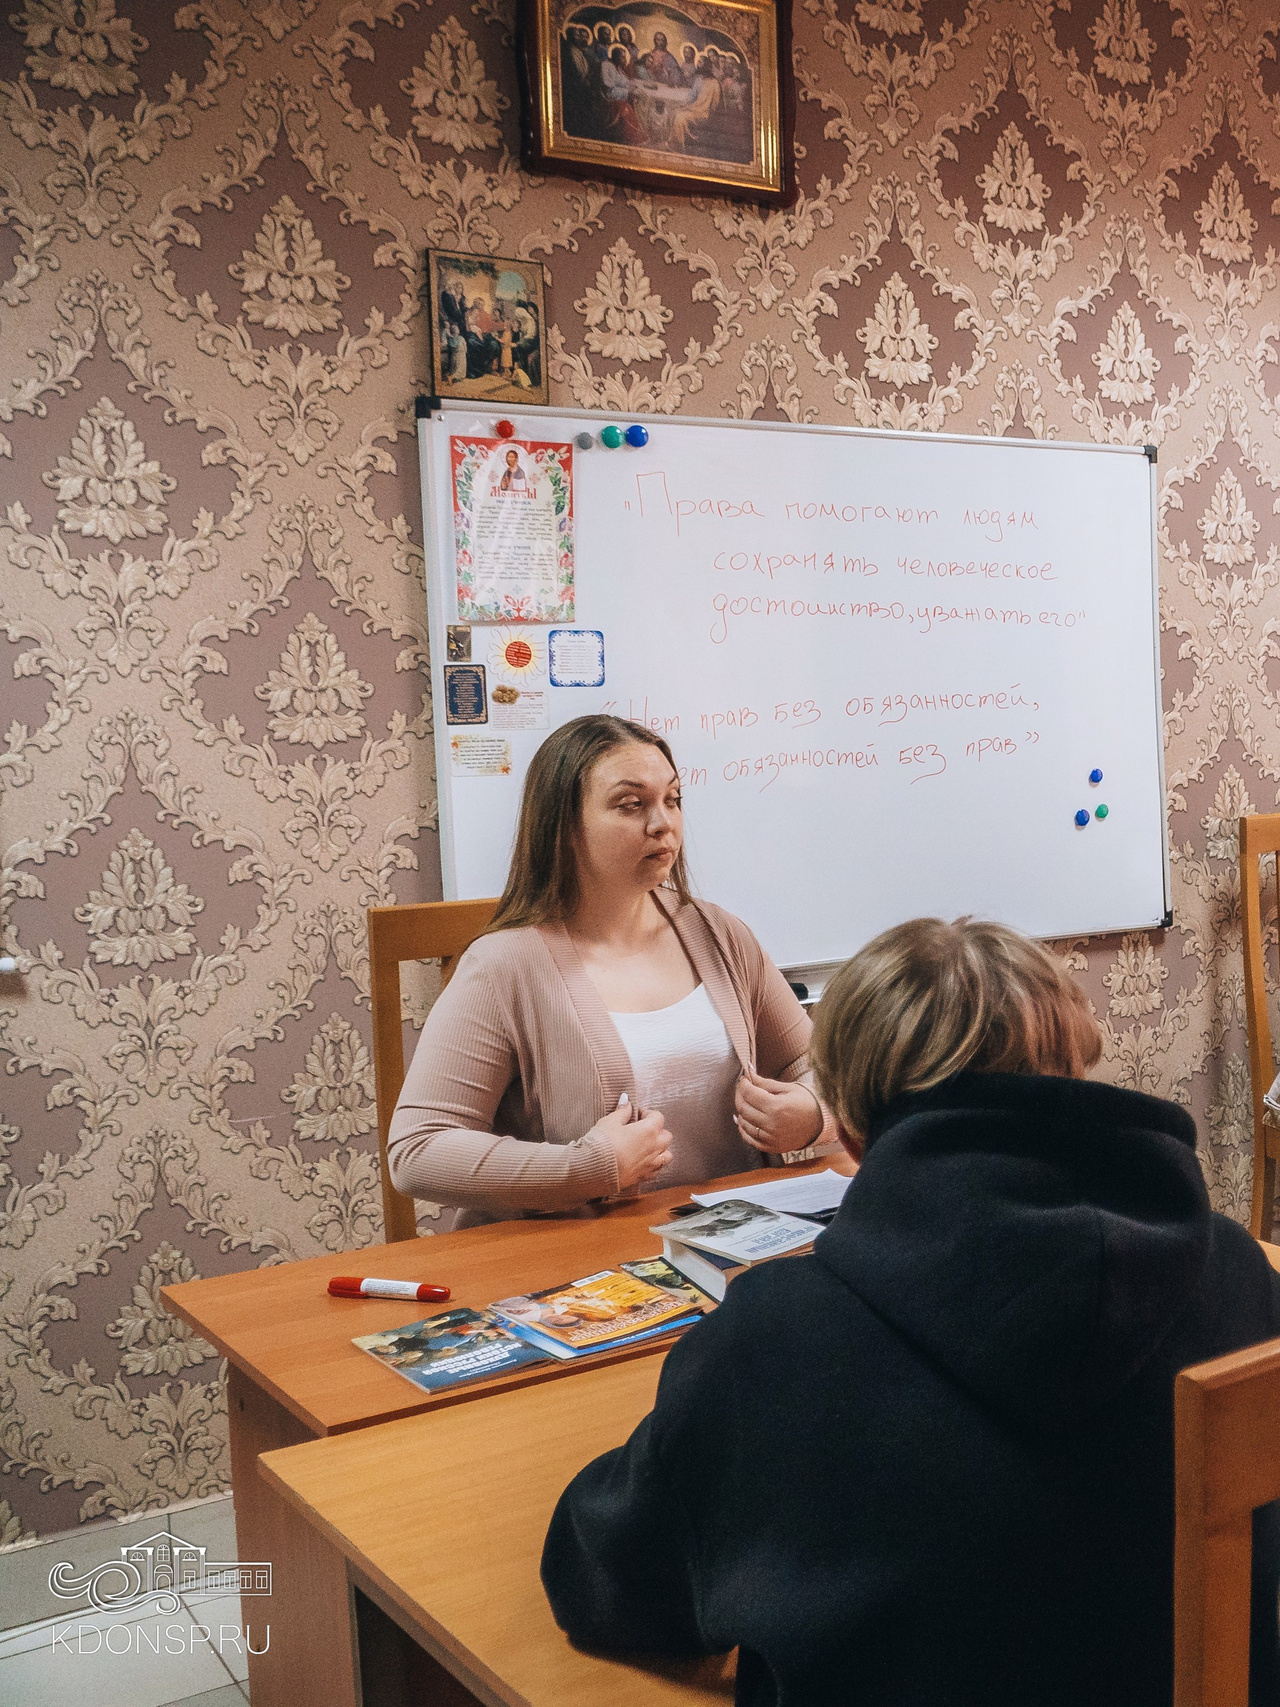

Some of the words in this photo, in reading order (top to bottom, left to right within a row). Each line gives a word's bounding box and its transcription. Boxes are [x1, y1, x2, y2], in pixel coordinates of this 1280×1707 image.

[785, 502, 939, 524] помогают
[963, 508, 1039, 543] людям
[713, 551, 879, 580] сохранять
[896, 556, 1059, 580] человеческое
[700, 706, 759, 740] прав
[676, 766, 708, 788] ет
[722, 743, 880, 794] обязанностей
